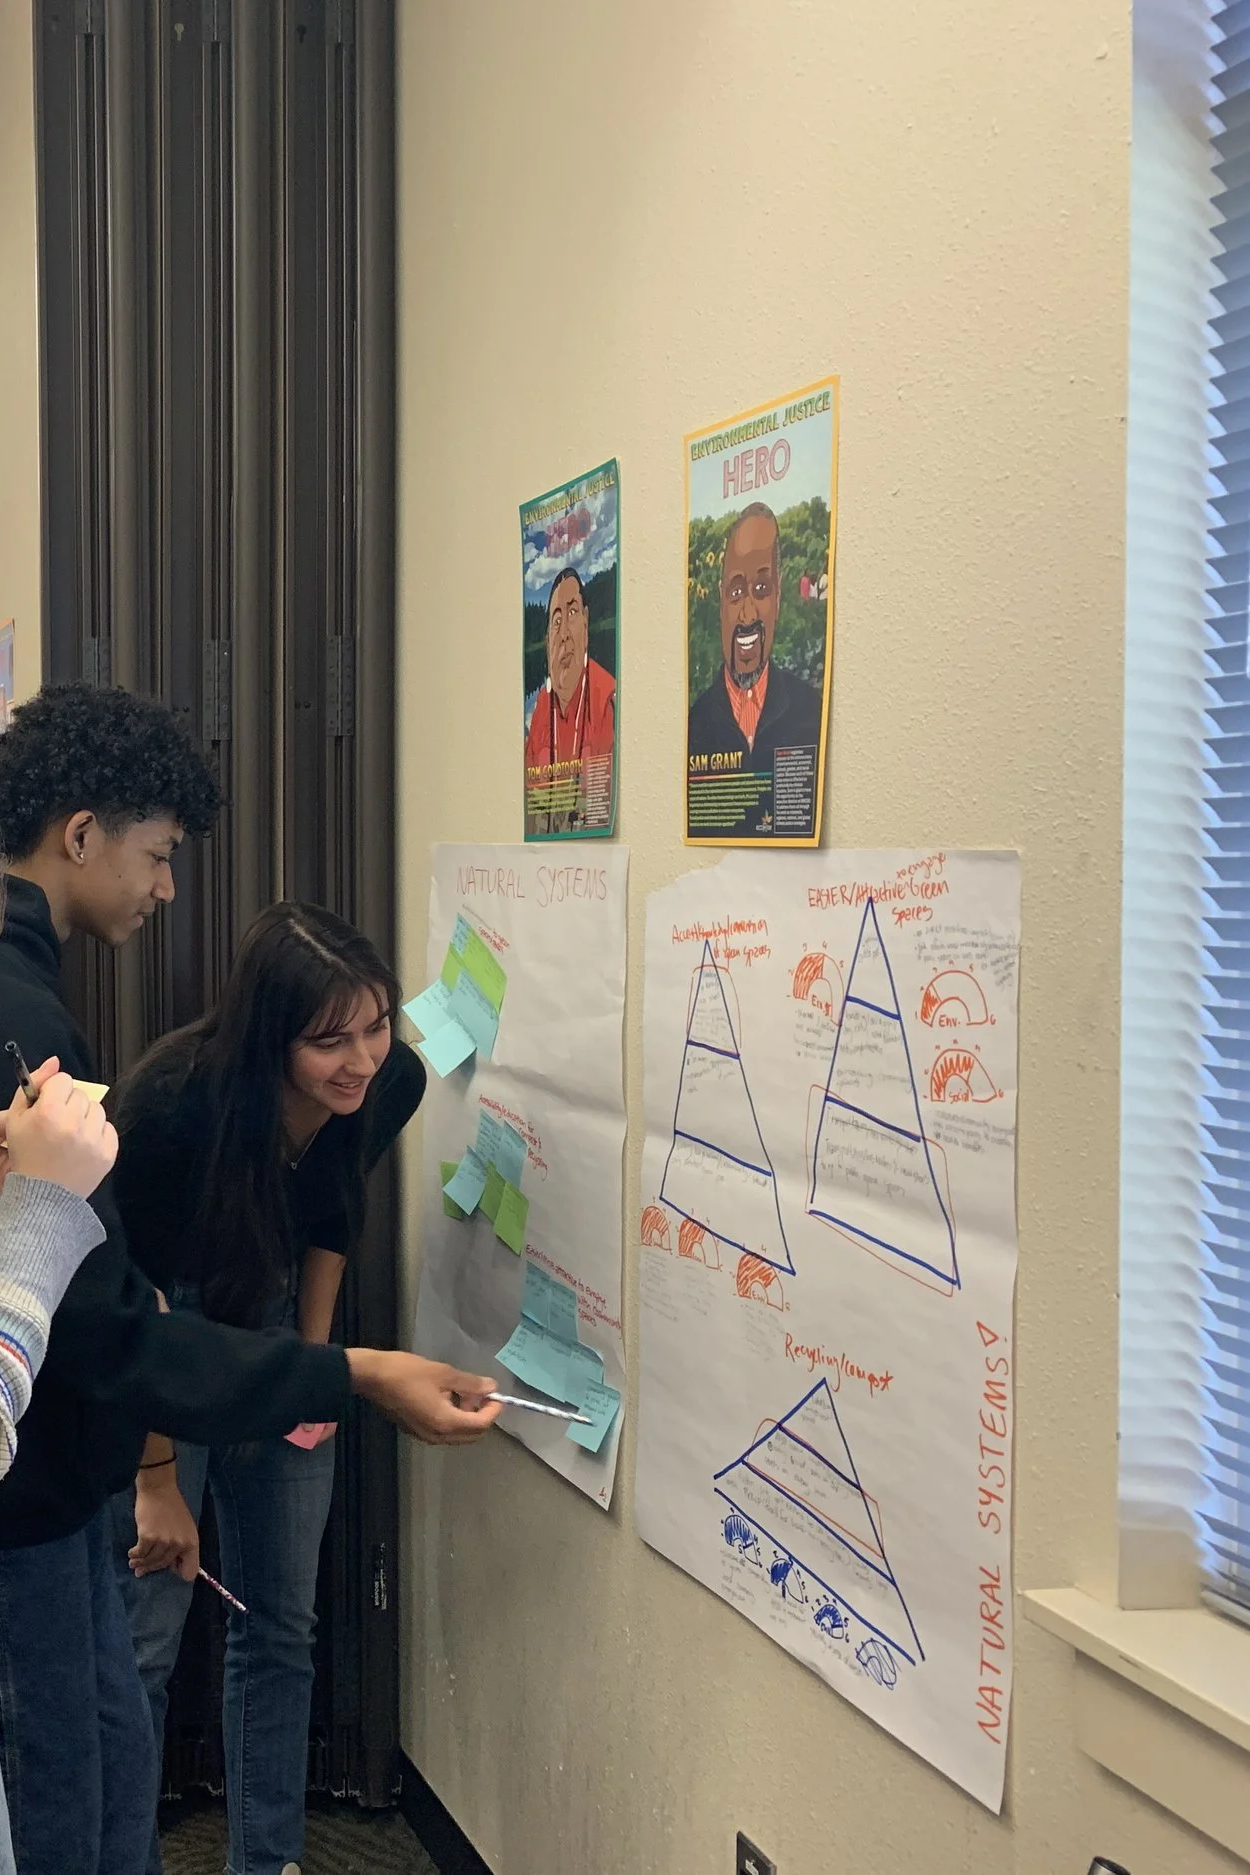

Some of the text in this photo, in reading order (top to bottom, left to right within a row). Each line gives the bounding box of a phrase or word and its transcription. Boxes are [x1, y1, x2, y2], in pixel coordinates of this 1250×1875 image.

[691, 390, 831, 461] ENVIRONMENTAL JUSTICE
[584, 471, 615, 499] JUSTICE
[722, 438, 791, 499] HERO
[527, 766, 541, 780] TOM
[689, 751, 743, 772] SAM GRANT
[456, 866, 607, 907] NATURAL SYSTEMS
[976, 1565, 1006, 1744] NATURAL
